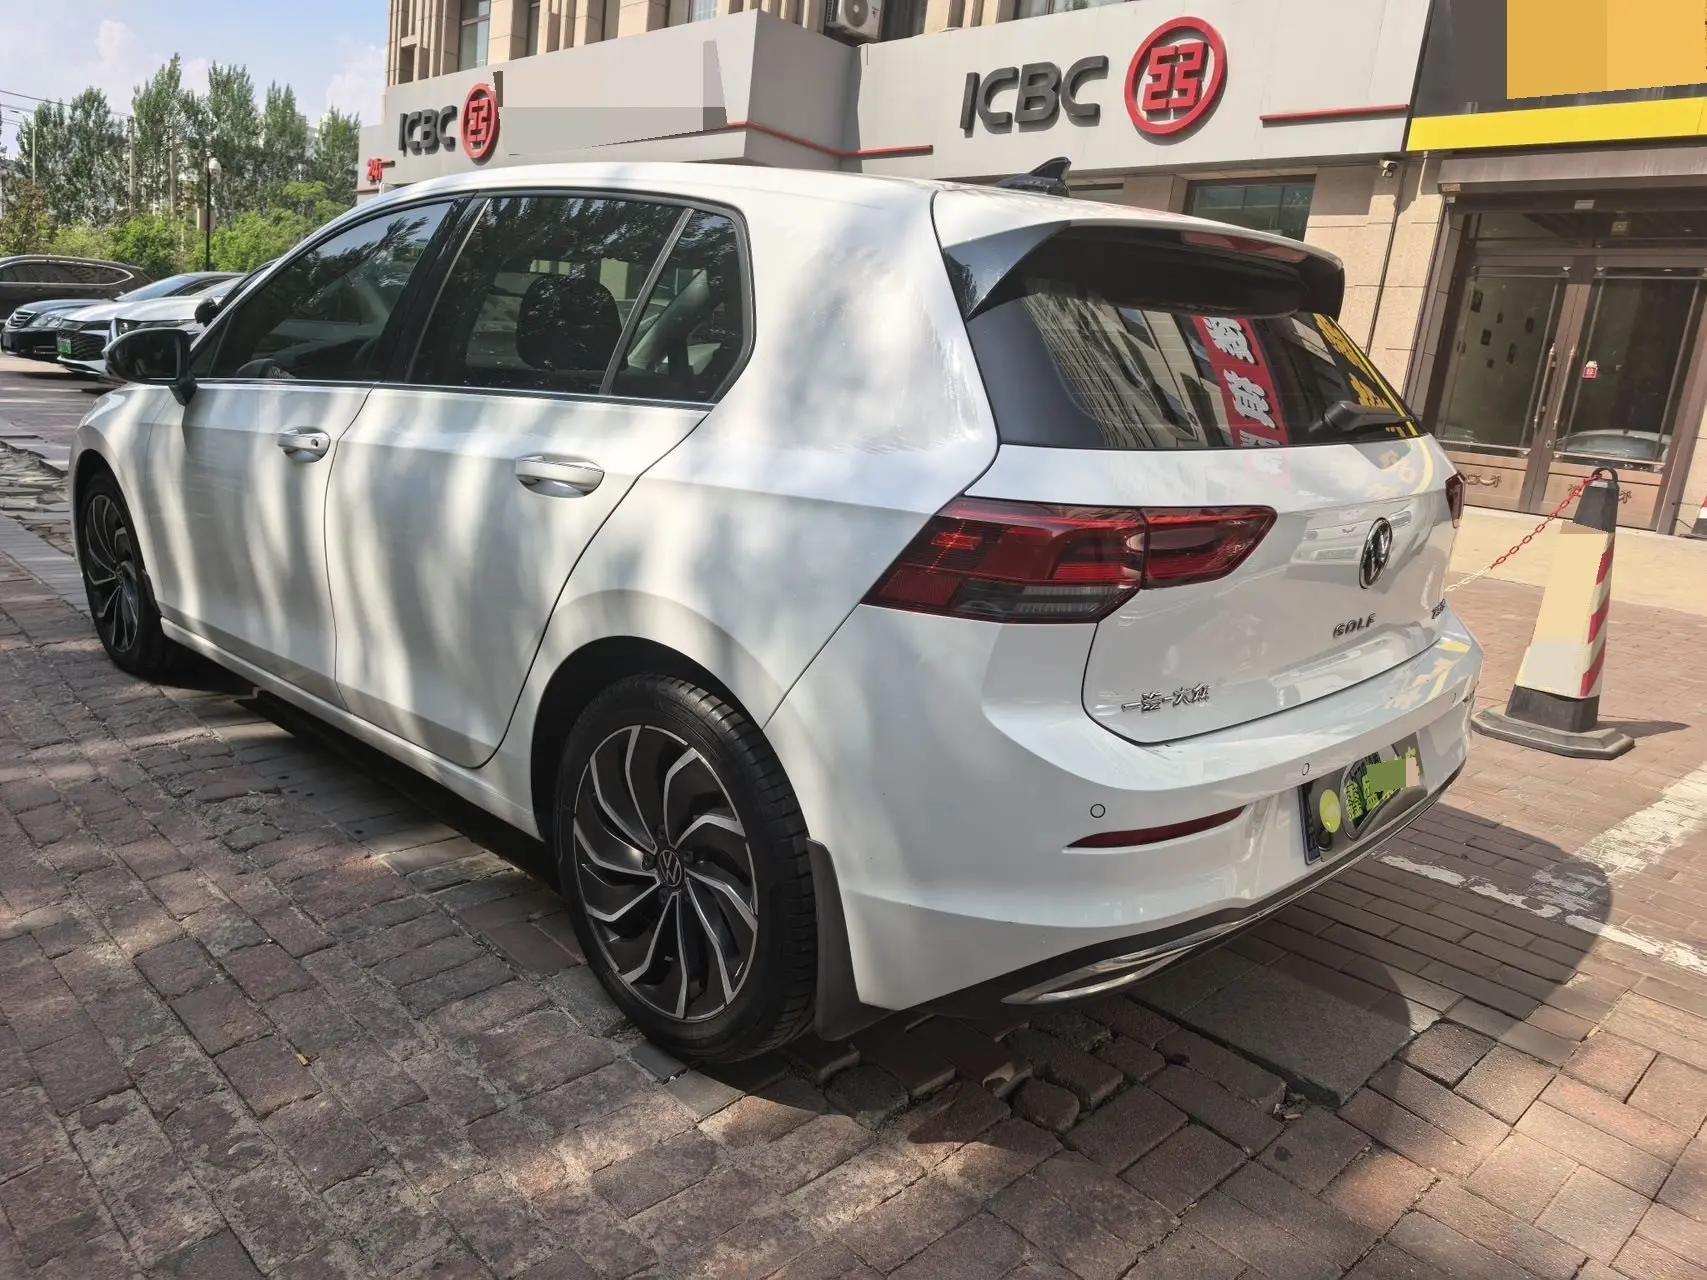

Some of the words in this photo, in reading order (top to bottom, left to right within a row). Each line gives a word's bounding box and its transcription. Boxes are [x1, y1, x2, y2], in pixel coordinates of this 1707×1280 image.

[960, 55, 1109, 134] ICBC
[398, 105, 458, 155] ICBC
[1332, 612, 1376, 639] GOLF
